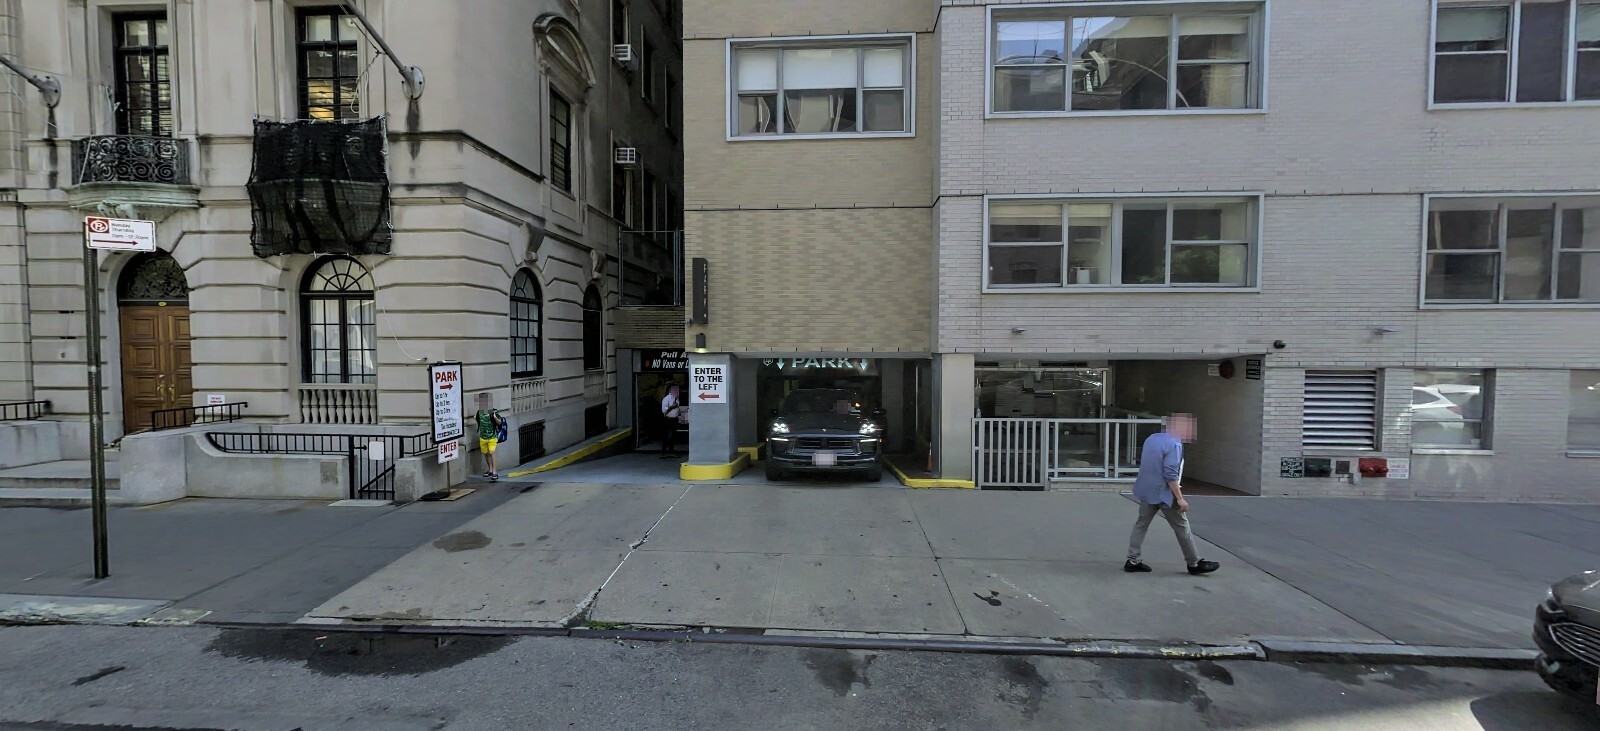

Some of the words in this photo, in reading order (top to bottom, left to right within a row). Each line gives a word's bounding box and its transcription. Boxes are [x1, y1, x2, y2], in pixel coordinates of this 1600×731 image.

[651, 359, 661, 369] NO
[662, 359, 676, 369] Vans
[677, 361, 685, 369] or
[792, 358, 853, 368] PARK
[694, 367, 722, 375] ENTER
[436, 370, 457, 383] PARK
[693, 375, 705, 383] TO
[706, 375, 723, 383] THE
[698, 383, 718, 391] LEFT
[440, 442, 456, 454] ENTER
